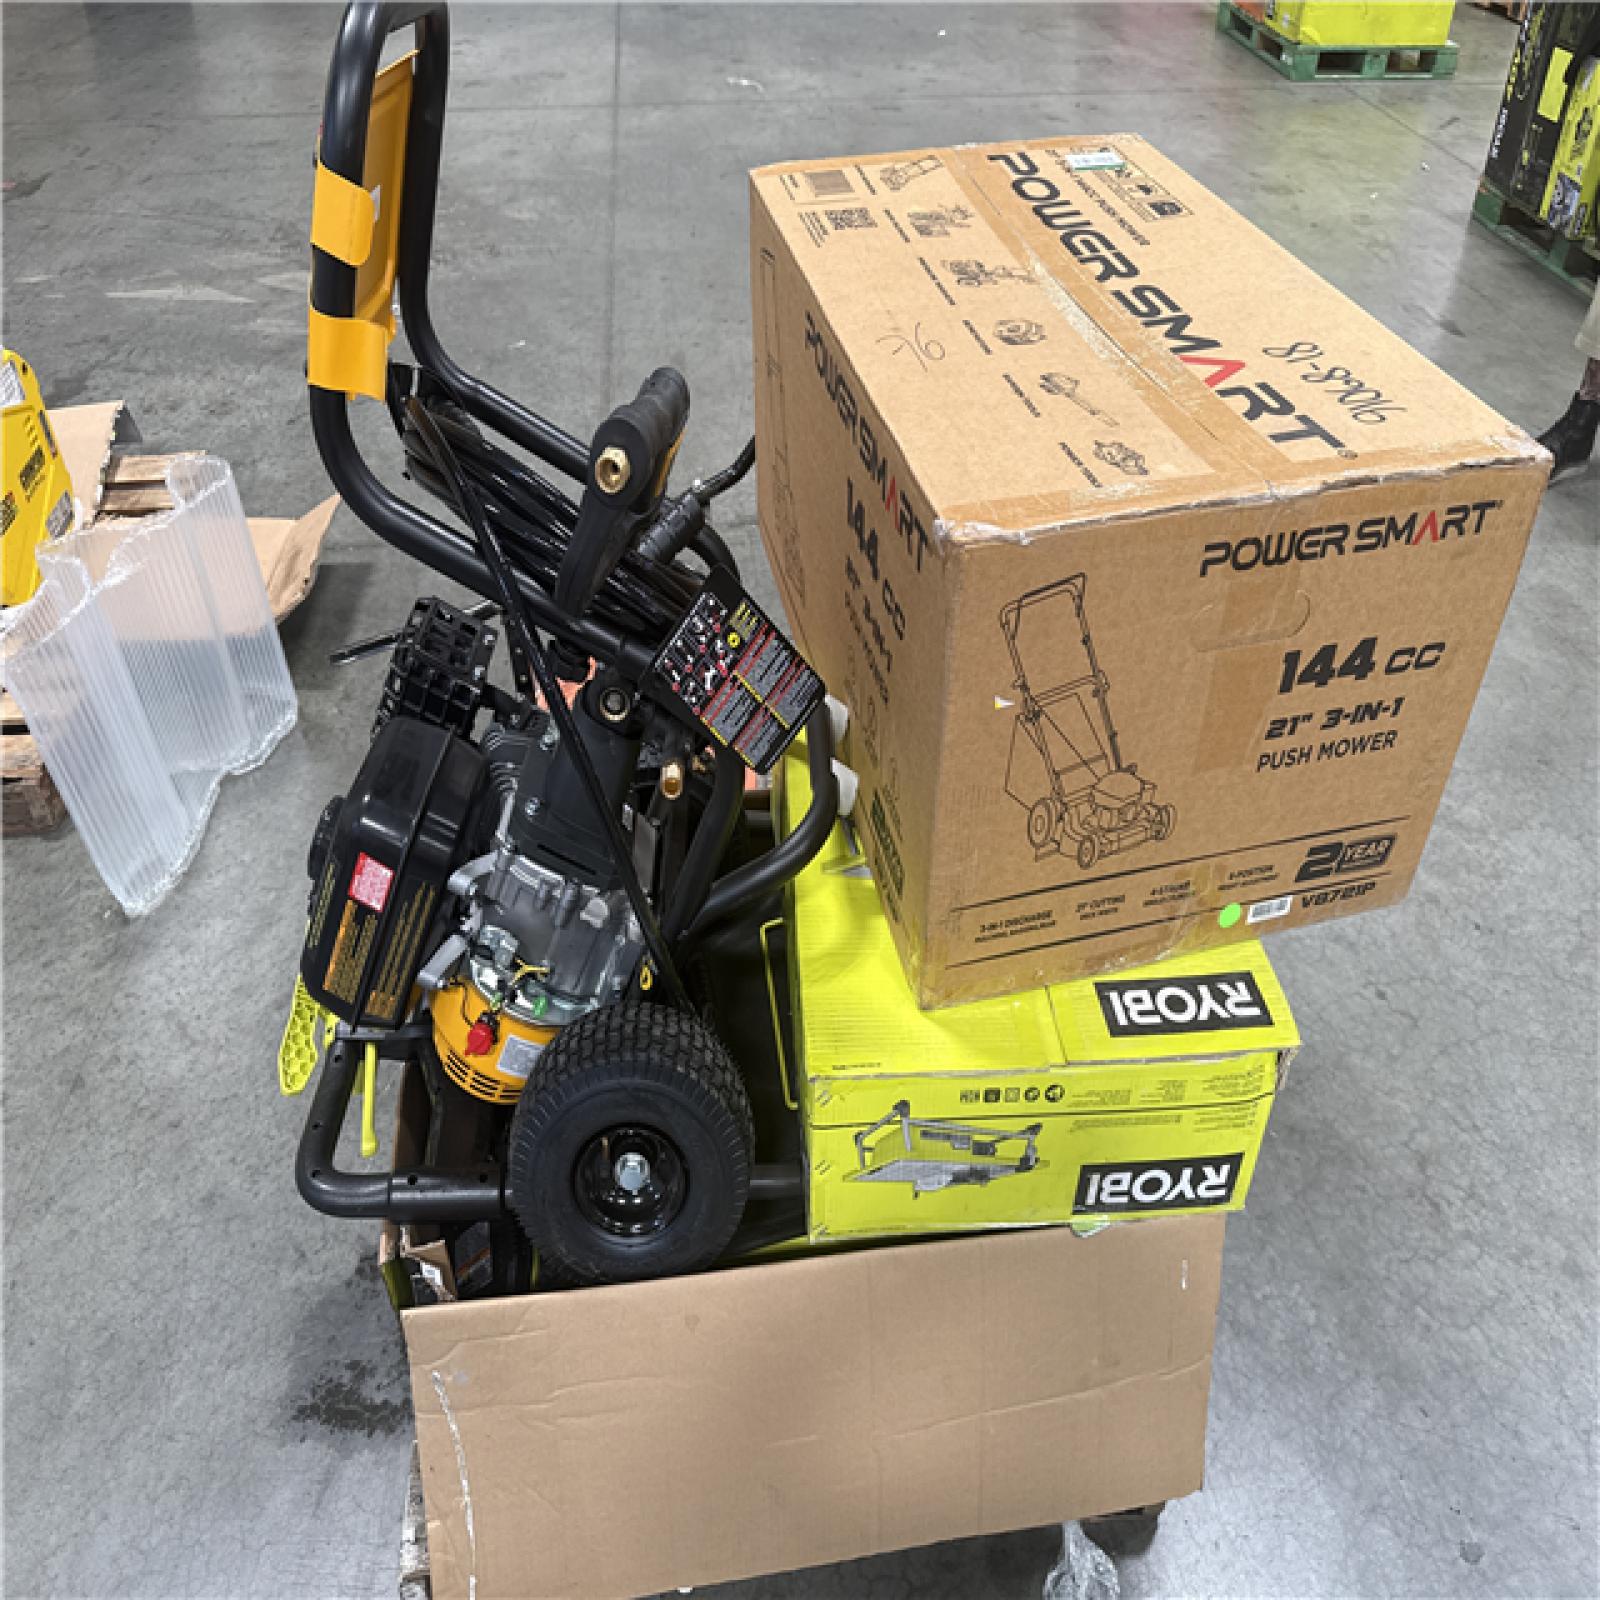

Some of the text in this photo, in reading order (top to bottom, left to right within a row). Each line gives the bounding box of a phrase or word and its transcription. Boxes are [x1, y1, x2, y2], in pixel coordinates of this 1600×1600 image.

[1277, 637, 1378, 694] 144
[1265, 697, 1405, 740] 21" 3-IN-1
[1256, 730, 1398, 773] PUSH MOWER
[1295, 842, 1344, 883] 2
[1108, 978, 1263, 1026] RYOBI
[1084, 1163, 1232, 1207] RYOBI
